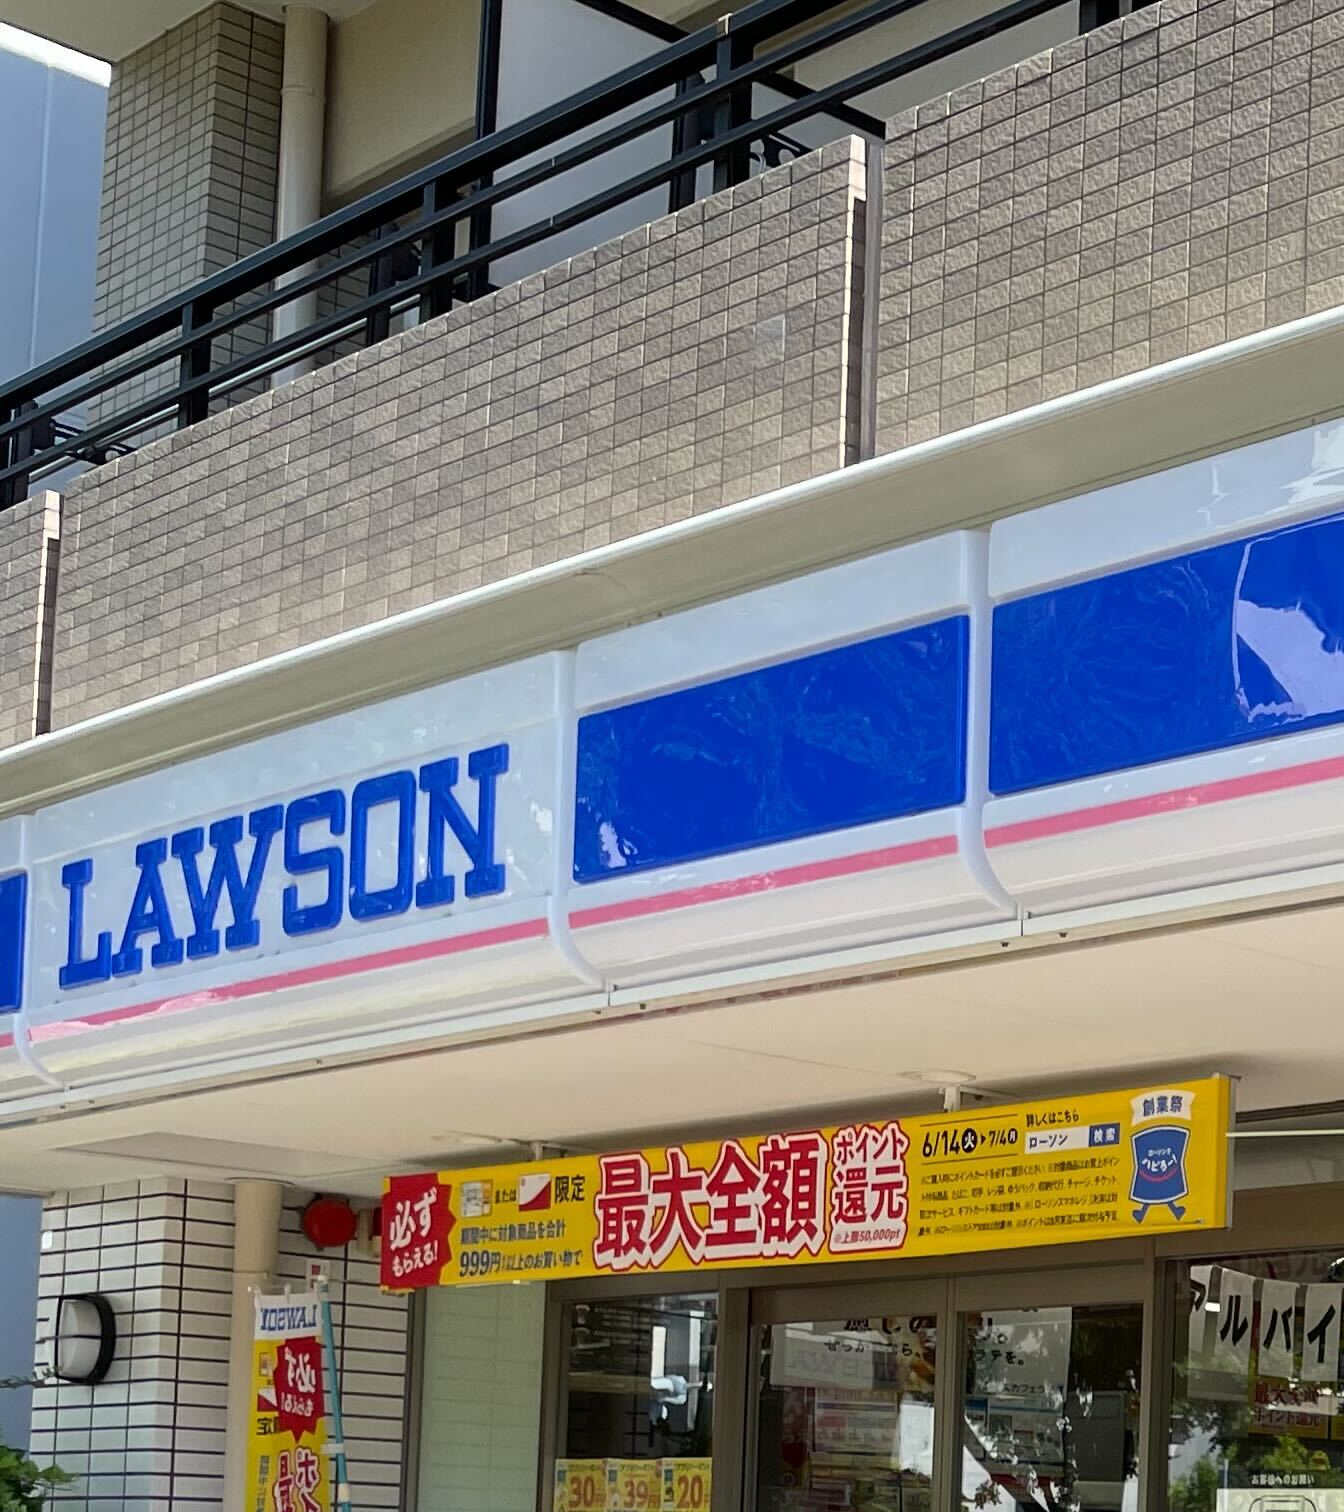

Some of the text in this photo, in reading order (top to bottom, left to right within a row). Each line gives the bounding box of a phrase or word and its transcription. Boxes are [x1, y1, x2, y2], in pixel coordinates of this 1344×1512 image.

[59, 743, 509, 990] LAWSON
[1026, 1108, 1080, 1128] 詳しくはこちら
[1143, 1095, 1183, 1117] 創業祭
[836, 1126, 905, 1164] ポイント
[1029, 1127, 1116, 1148] ローソン 検索
[495, 1175, 585, 1204] または 限定
[594, 1133, 822, 1263] 最大全額
[834, 1165, 904, 1224] 還元
[390, 1186, 438, 1251] 必ず
[392, 1240, 438, 1278] もらえる!
